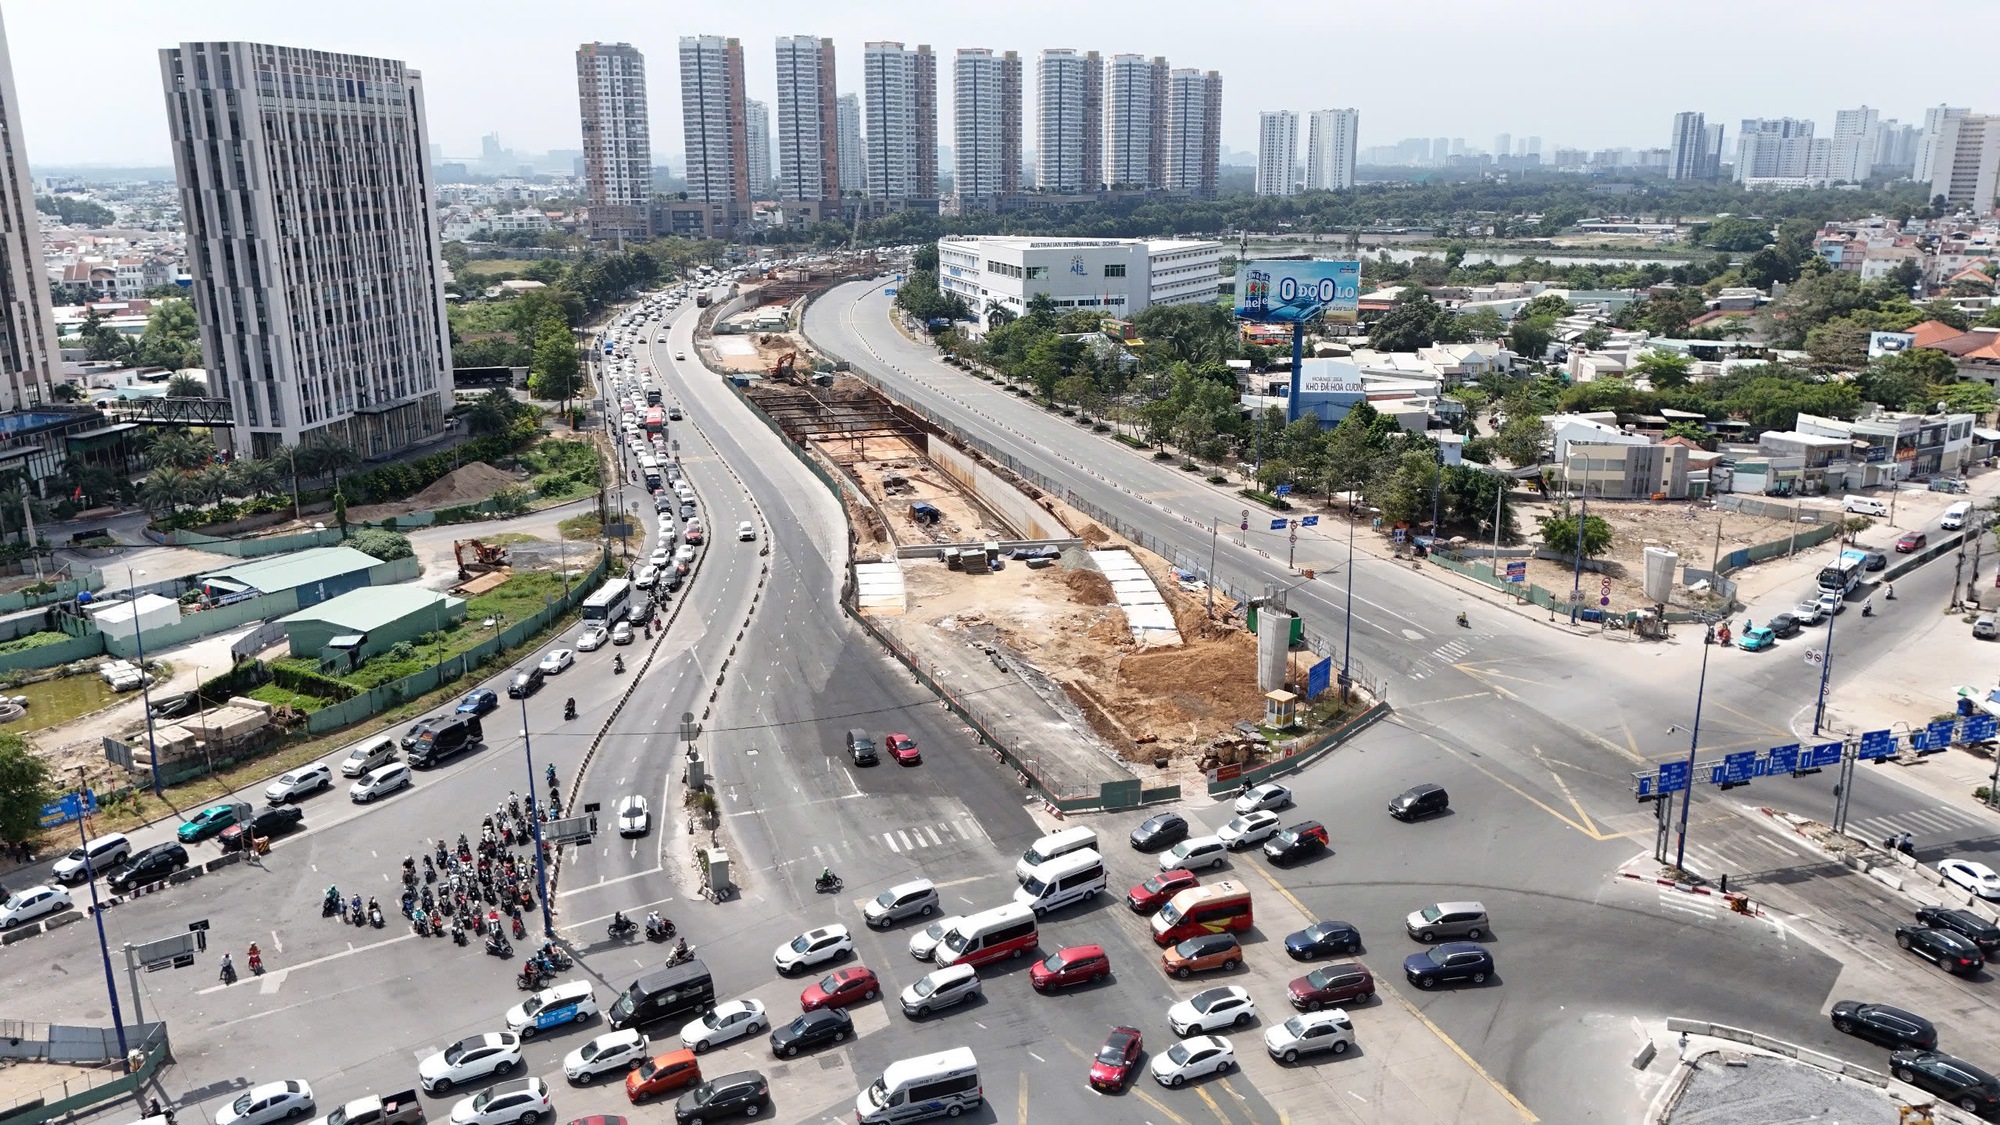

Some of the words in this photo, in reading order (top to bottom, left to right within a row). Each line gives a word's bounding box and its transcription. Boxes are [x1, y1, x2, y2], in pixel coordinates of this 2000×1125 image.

[1336, 286, 1355, 298] LO
[1305, 382, 1319, 391] KHO
[1330, 382, 1344, 391] HOA
